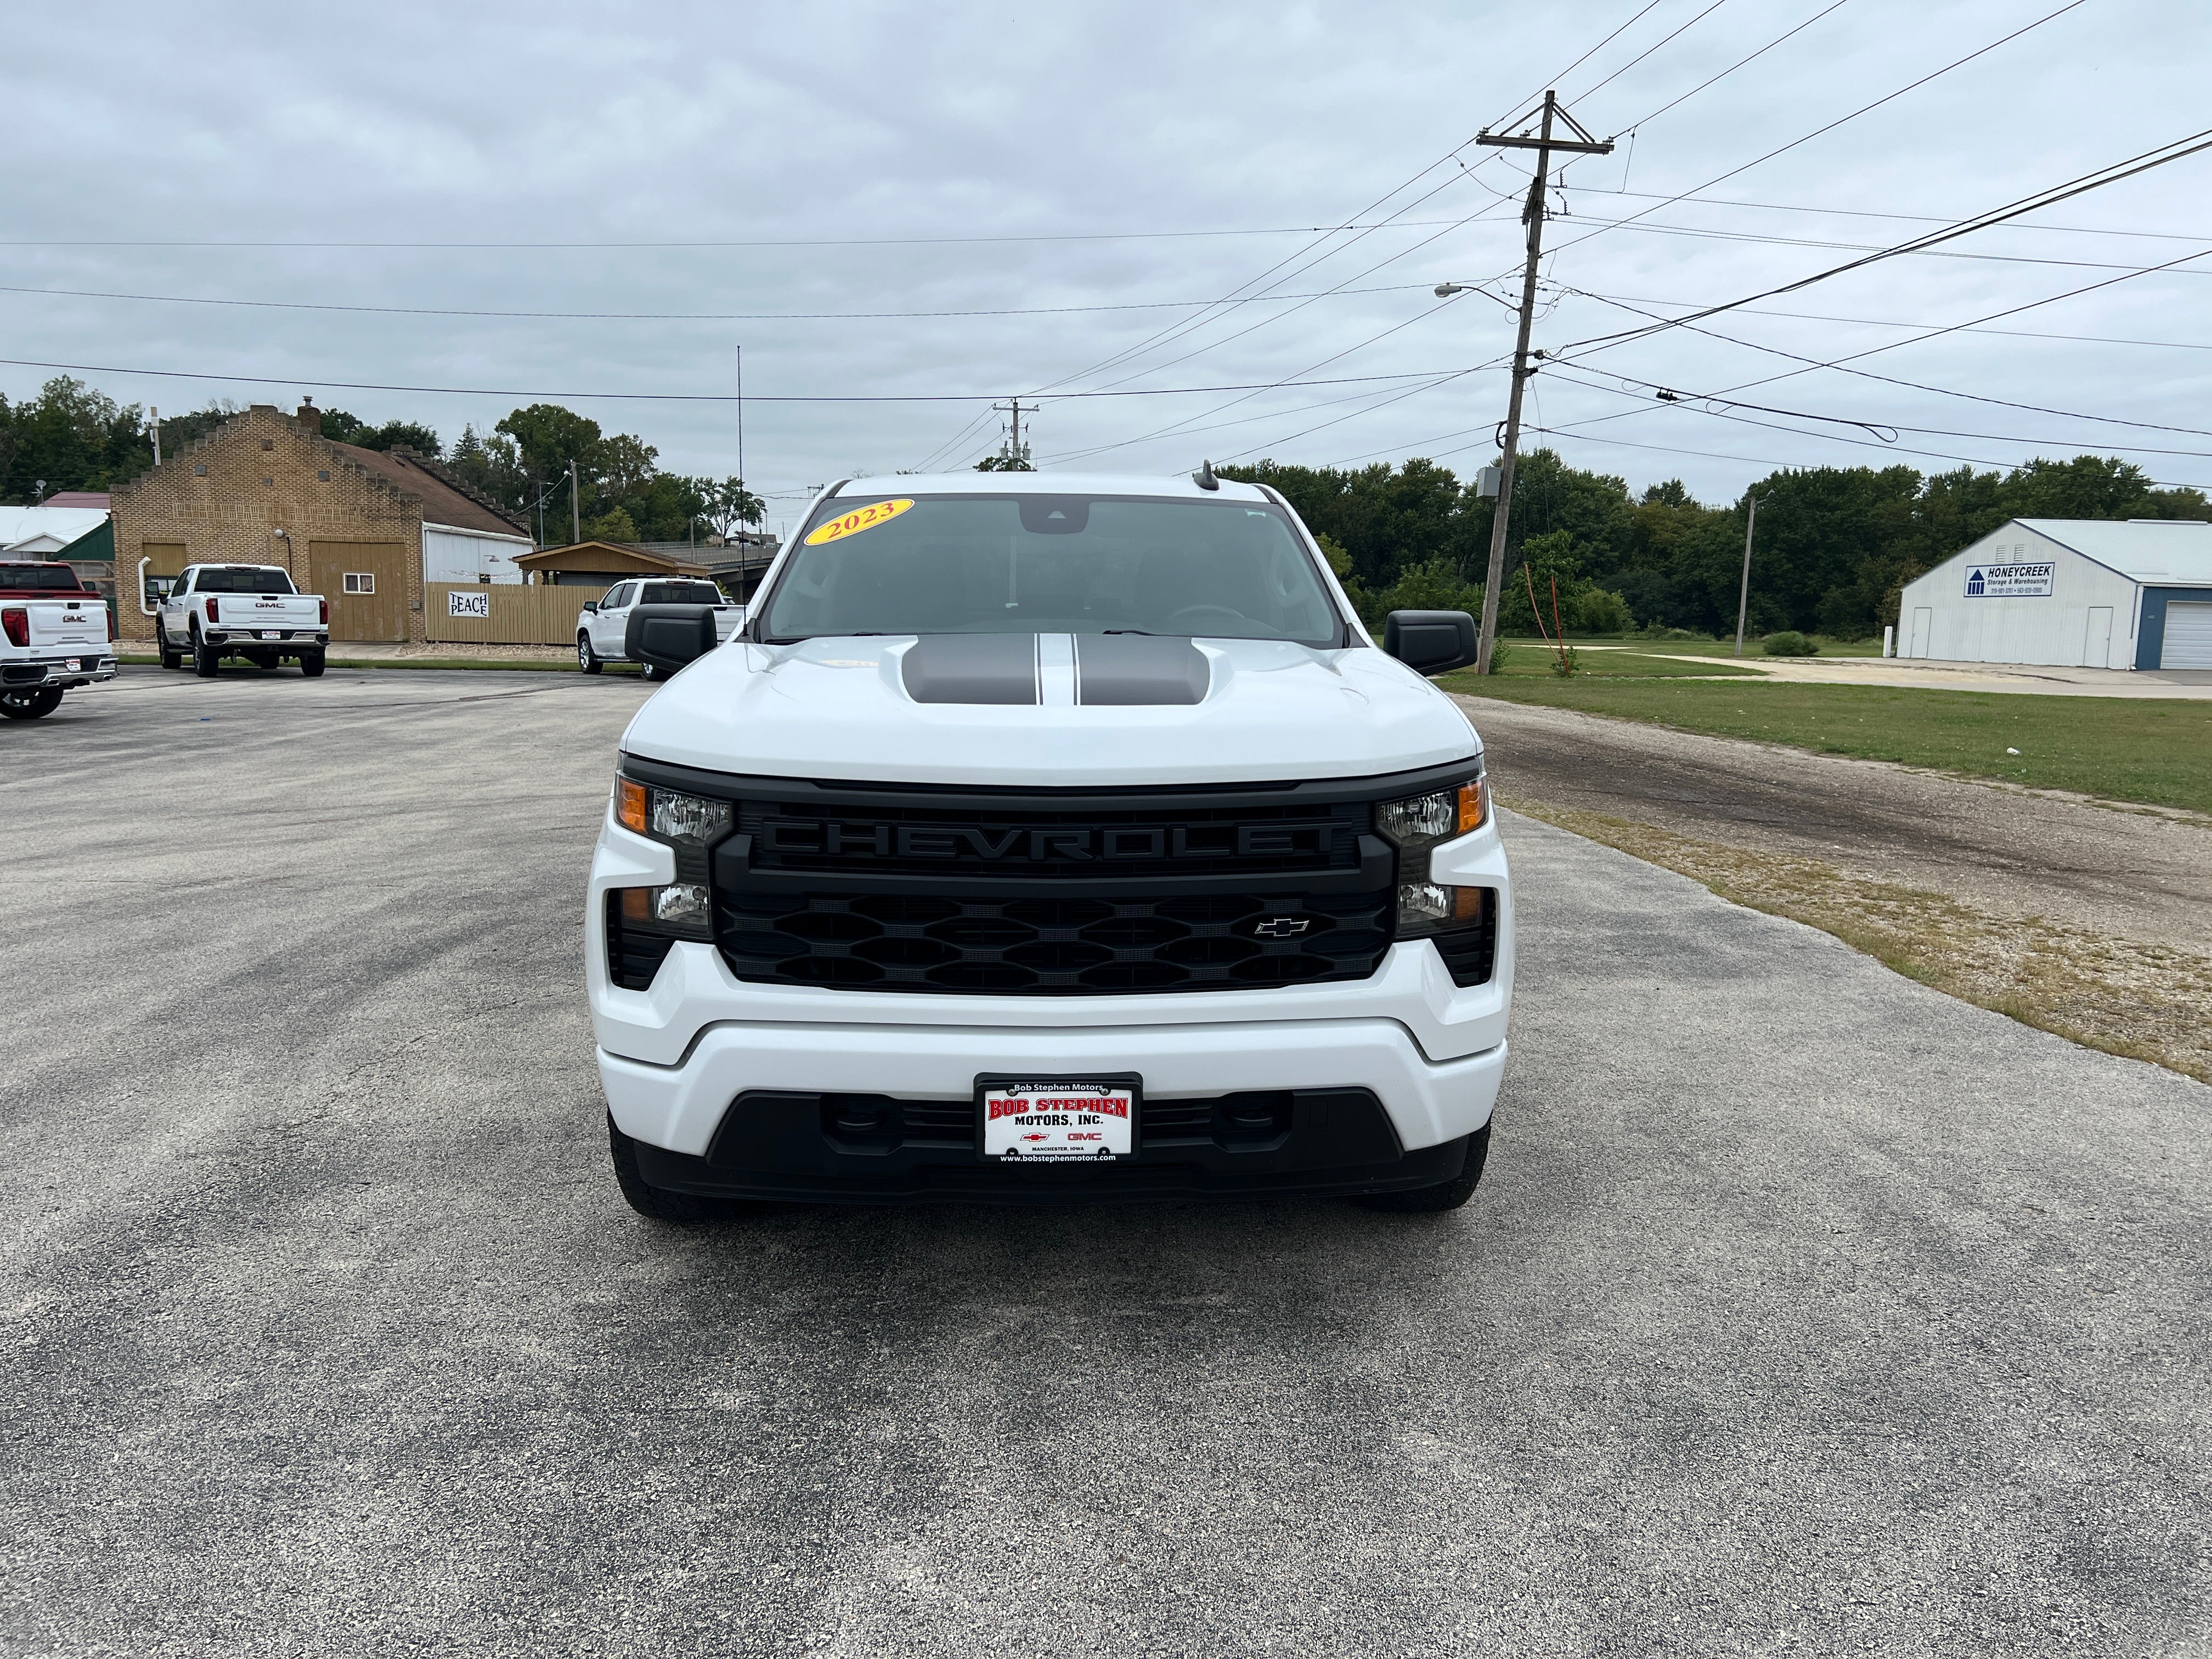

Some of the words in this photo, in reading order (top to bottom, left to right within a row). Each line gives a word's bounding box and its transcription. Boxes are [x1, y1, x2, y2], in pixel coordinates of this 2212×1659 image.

[827, 503, 894, 539] 2023
[1988, 566, 2052, 578] HONEYCREEK
[450, 592, 487, 613] TEACH
[763, 821, 1353, 860] CHEVROLET
[1034, 1084, 1070, 1092] Stephen
[988, 1099, 1029, 1121] BOB
[1035, 1098, 1128, 1119] STEPHEN
[1014, 1114, 1073, 1127] MOTORS,
[1078, 1114, 1104, 1125] INC.
[1067, 1132, 1102, 1141] GMC
[1000, 1154, 1116, 1163] www.bobstephenmotors.com
